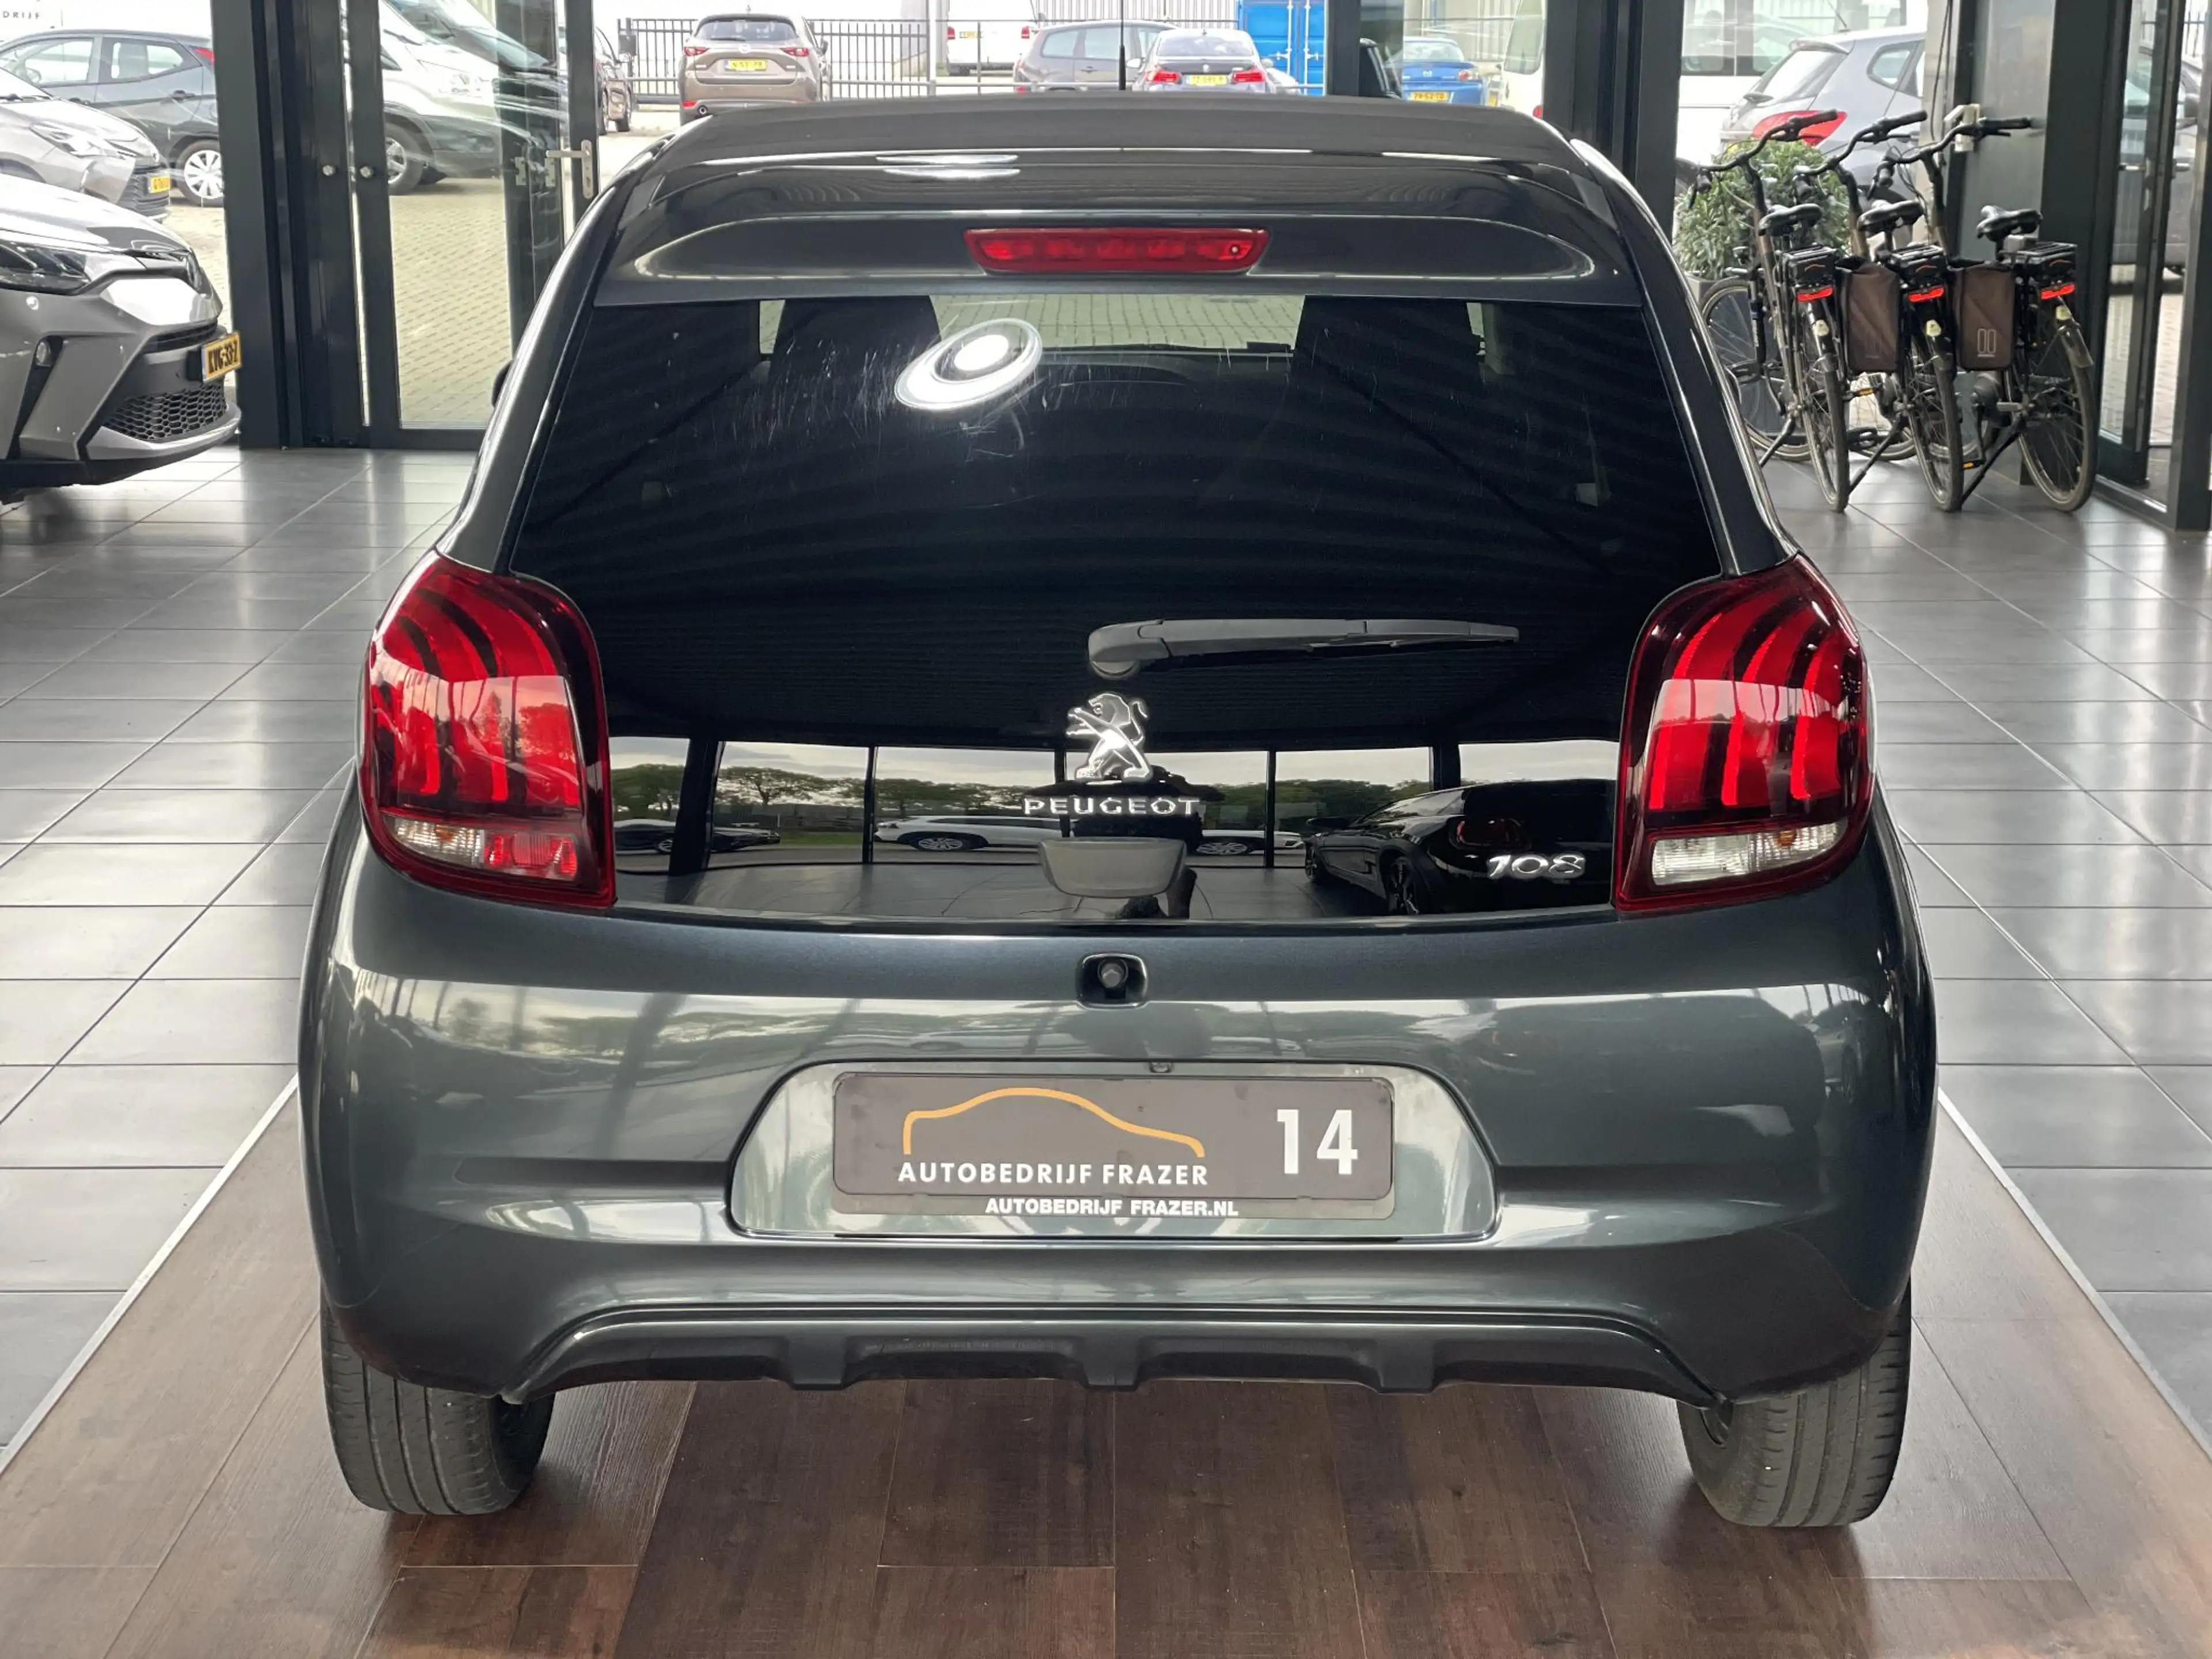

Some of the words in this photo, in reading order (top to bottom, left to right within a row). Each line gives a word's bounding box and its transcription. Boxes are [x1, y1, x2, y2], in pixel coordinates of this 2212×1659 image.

[1024, 797, 1200, 815] PEUGEOT
[1487, 854, 1585, 879] 108
[1277, 1109, 1358, 1175] 14
[897, 1162, 1092, 1183] AUTOBEDRIJF
[1102, 1164, 1209, 1185] FRAZER
[985, 1198, 1123, 1215] AUTOBEDRIJF
[1130, 1199, 1239, 1216] FRAZER.NL
